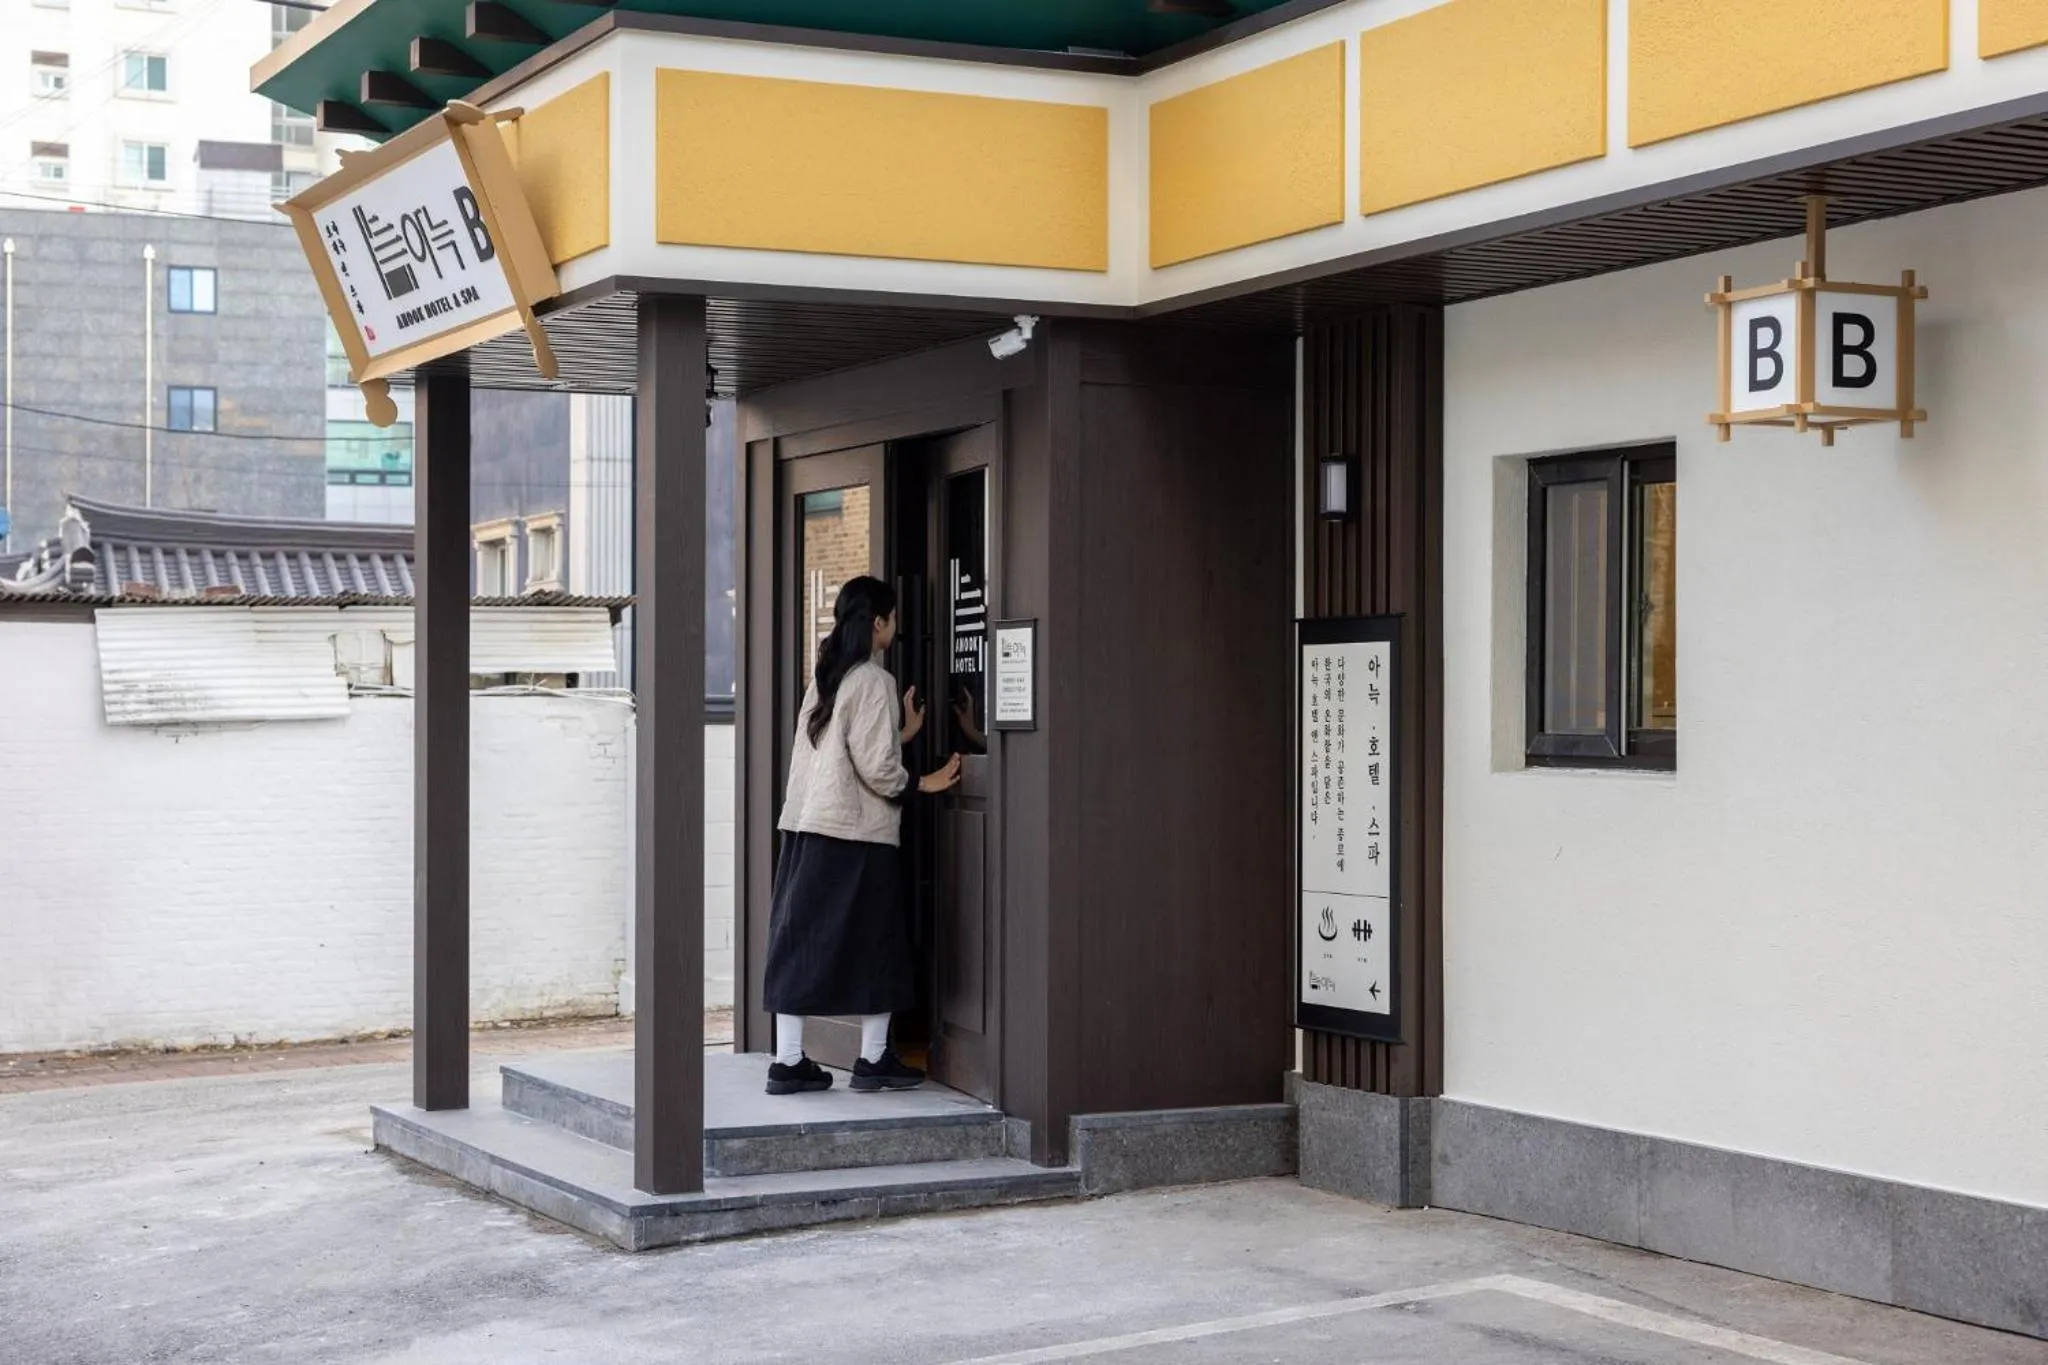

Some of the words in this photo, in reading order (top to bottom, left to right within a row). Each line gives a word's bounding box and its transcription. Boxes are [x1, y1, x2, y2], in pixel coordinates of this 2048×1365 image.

[453, 186, 495, 262] B
[424, 296, 454, 318] HOTEL
[460, 285, 480, 305] SPA
[1749, 316, 1784, 392] B
[1832, 312, 1877, 388] B
[955, 636, 978, 653] ANOOK
[955, 657, 976, 673] HOTEL
[1368, 655, 1380, 705] 아늑
